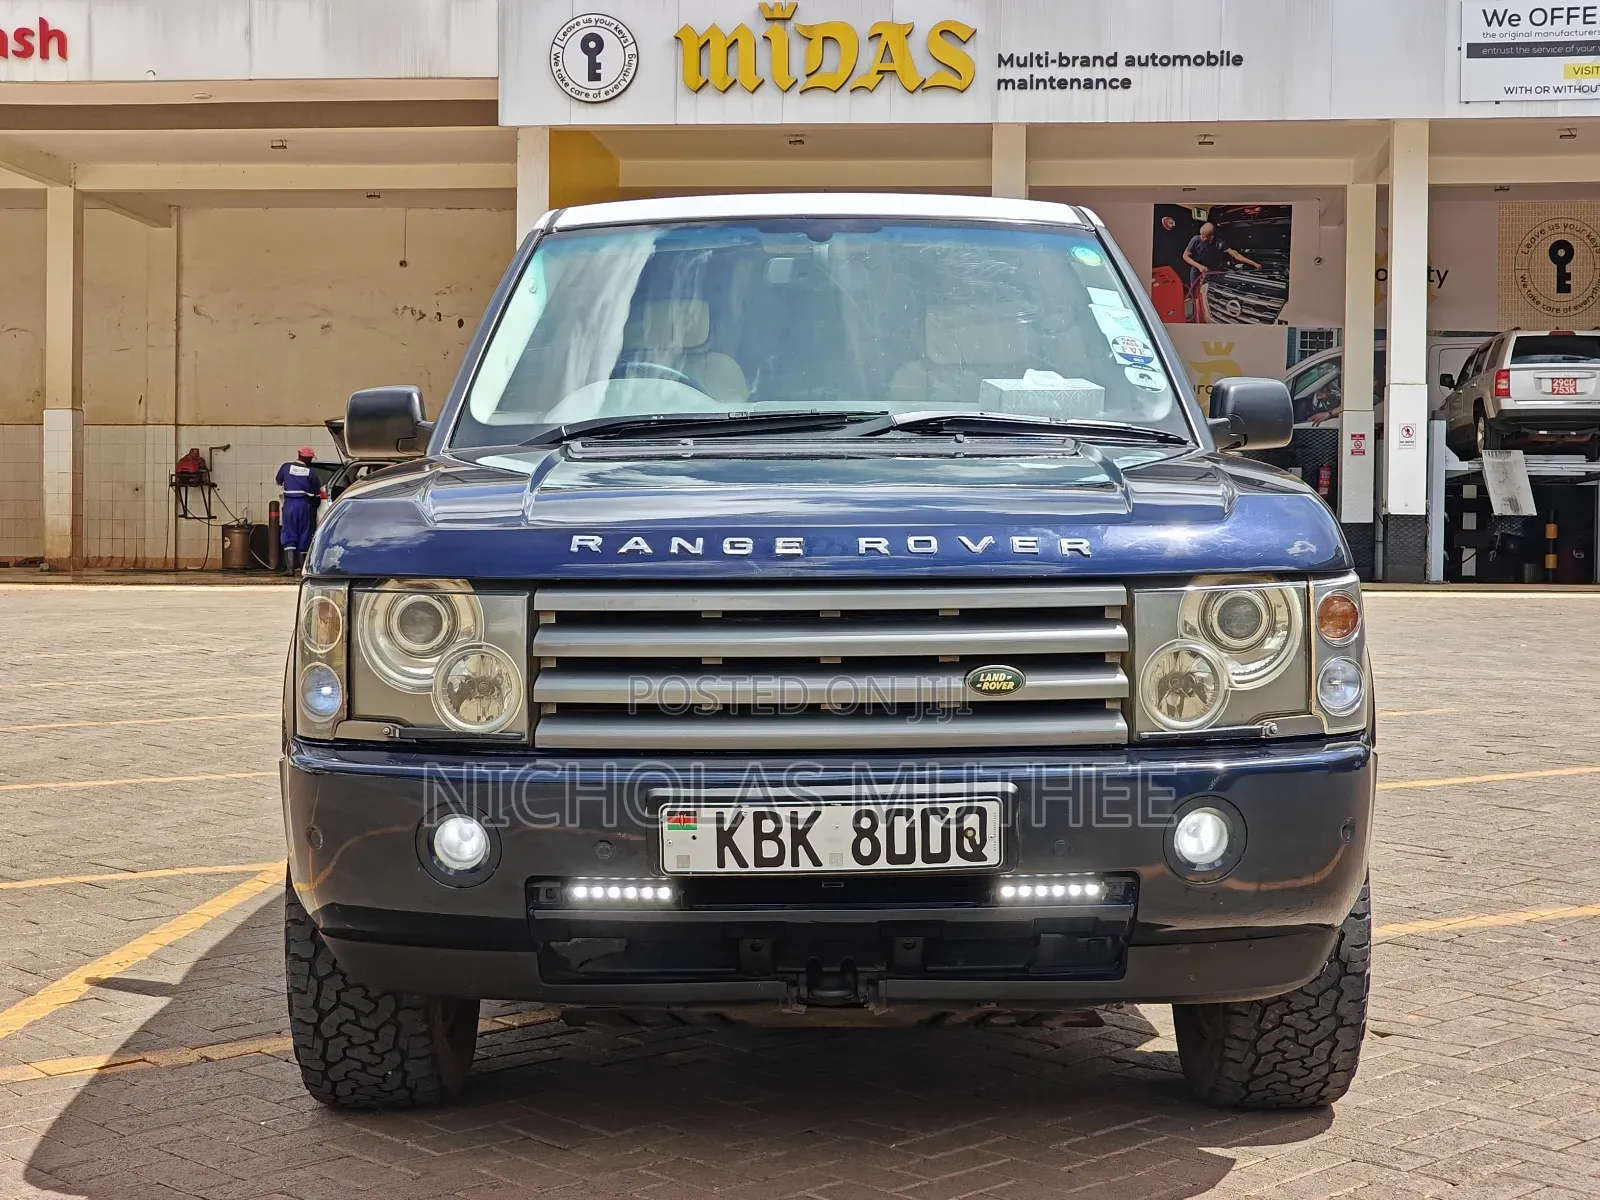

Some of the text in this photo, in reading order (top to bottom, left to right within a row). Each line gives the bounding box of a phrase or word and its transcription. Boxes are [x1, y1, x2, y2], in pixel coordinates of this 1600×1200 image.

[1482, 6, 1600, 27] We OFFE
[557, 21, 581, 42] Leave
[594, 17, 615, 28] your
[614, 24, 629, 44] keys
[1482, 31, 1496, 39] the
[1499, 30, 1532, 40] original
[997, 50, 1244, 68] Multi-brand automobile
[1482, 47, 1513, 55] entrust
[1515, 46, 1530, 54] the
[1532, 45, 1564, 53] service
[1565, 44, 1575, 52] of
[1576, 45, 1596, 54] your
[553, 52, 636, 99] We take care of everything
[997, 74, 1132, 90] maintenance
[1504, 86, 1533, 95] WITH
[1534, 85, 1551, 94] OR
[1521, 223, 1600, 255] Leave us your keys
[1520, 274, 1527, 288] We
[1526, 290, 1541, 306] take
[1541, 304, 1560, 313] care
[1563, 305, 1572, 314] of
[570, 535, 1092, 558] RANGE ROVER
[979, 673, 1006, 681] LAND
[982, 681, 1015, 690] ROVER
[715, 811, 823, 868] KBK
[851, 806, 987, 866] 800Q
